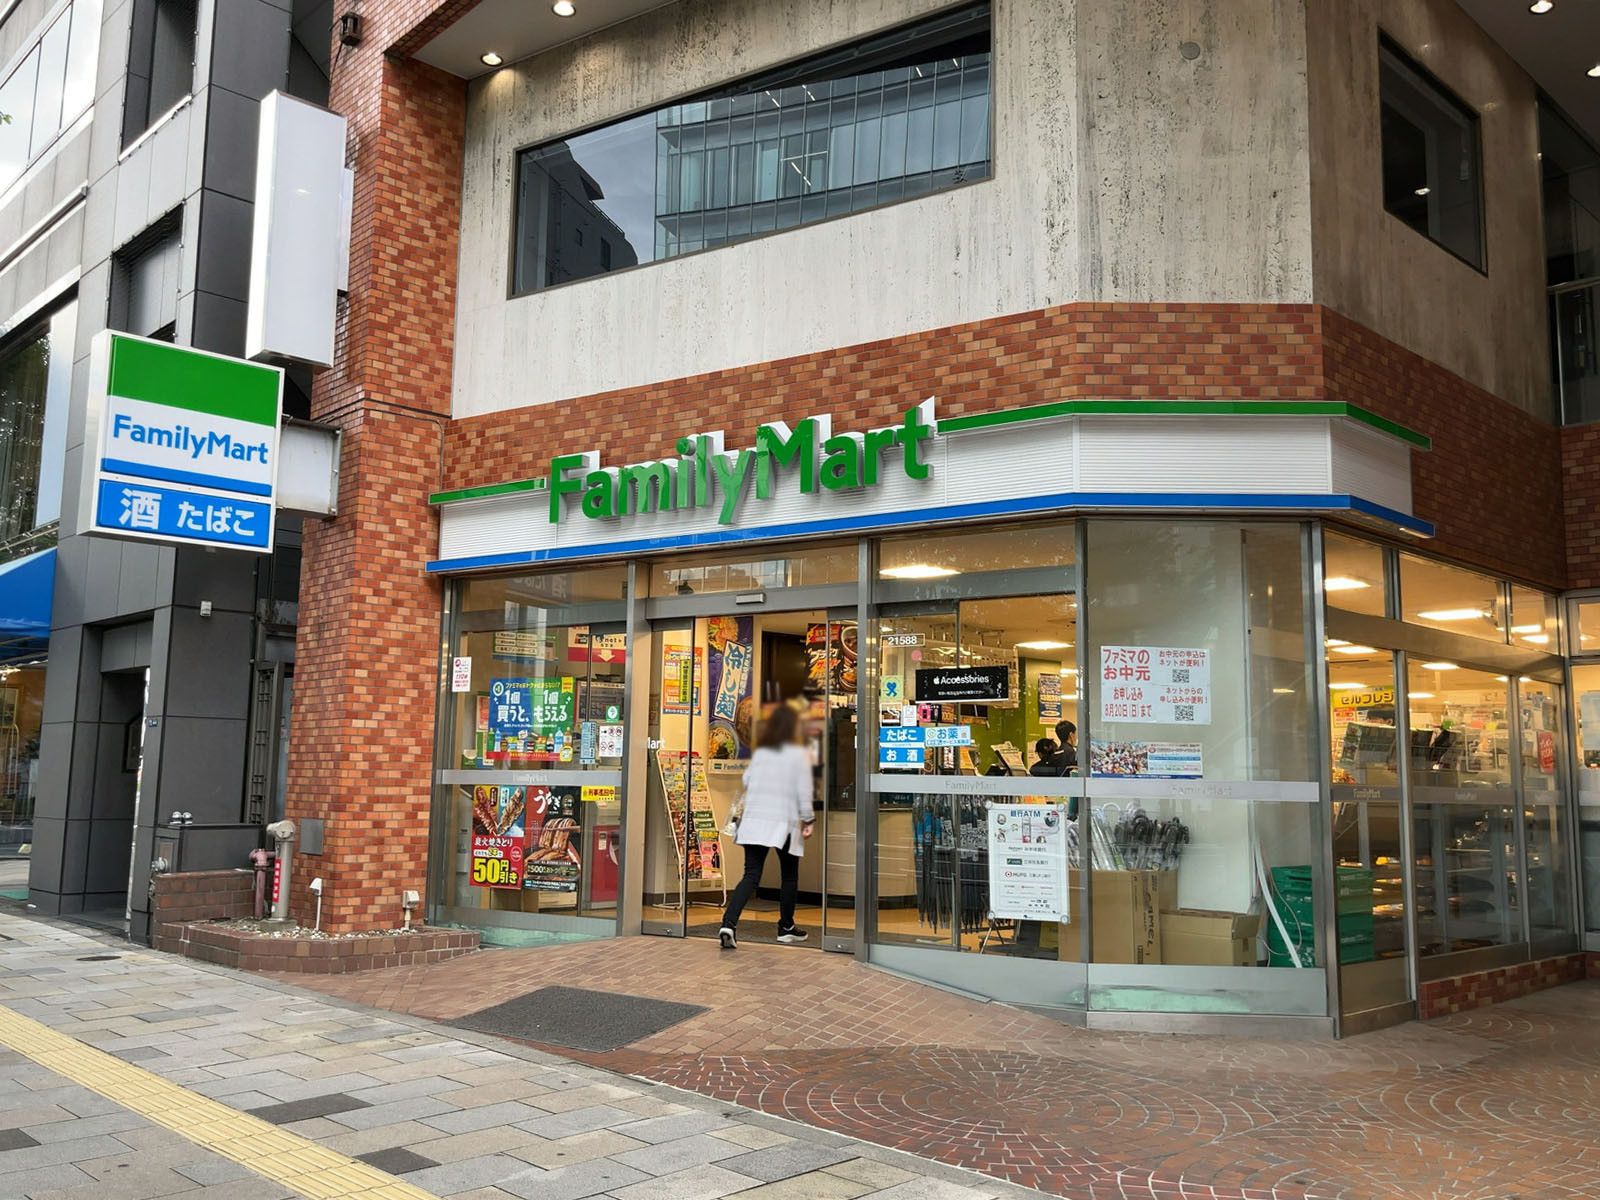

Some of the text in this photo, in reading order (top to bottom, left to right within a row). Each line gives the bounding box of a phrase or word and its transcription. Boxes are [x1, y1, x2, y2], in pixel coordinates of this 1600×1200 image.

[112, 413, 269, 464] FamilyMart
[549, 403, 935, 525] FamilyMart
[119, 488, 256, 538] 酒 たばこ
[888, 636, 918, 646] 21588
[1102, 648, 1151, 665] ファミマの
[1159, 650, 1206, 659] お中元の申込は
[940, 675, 990, 685] Accessories
[1103, 665, 1151, 681] お中元
[504, 689, 521, 704] 1個
[543, 689, 559, 704] 1個
[1113, 687, 1143, 701] お申し込み
[1165, 687, 1203, 695] ネットからの
[1340, 692, 1394, 705] セルフレジ
[497, 705, 530, 723] 買うと、
[533, 705, 568, 723] もらえる
[886, 729, 918, 741] たばこ
[937, 728, 959, 739] お薬
[886, 750, 918, 761] お酒
[945, 780, 997, 792] FamilyMart
[534, 789, 561, 814] うなぎ
[1010, 810, 1041, 818] 銀行ATM
